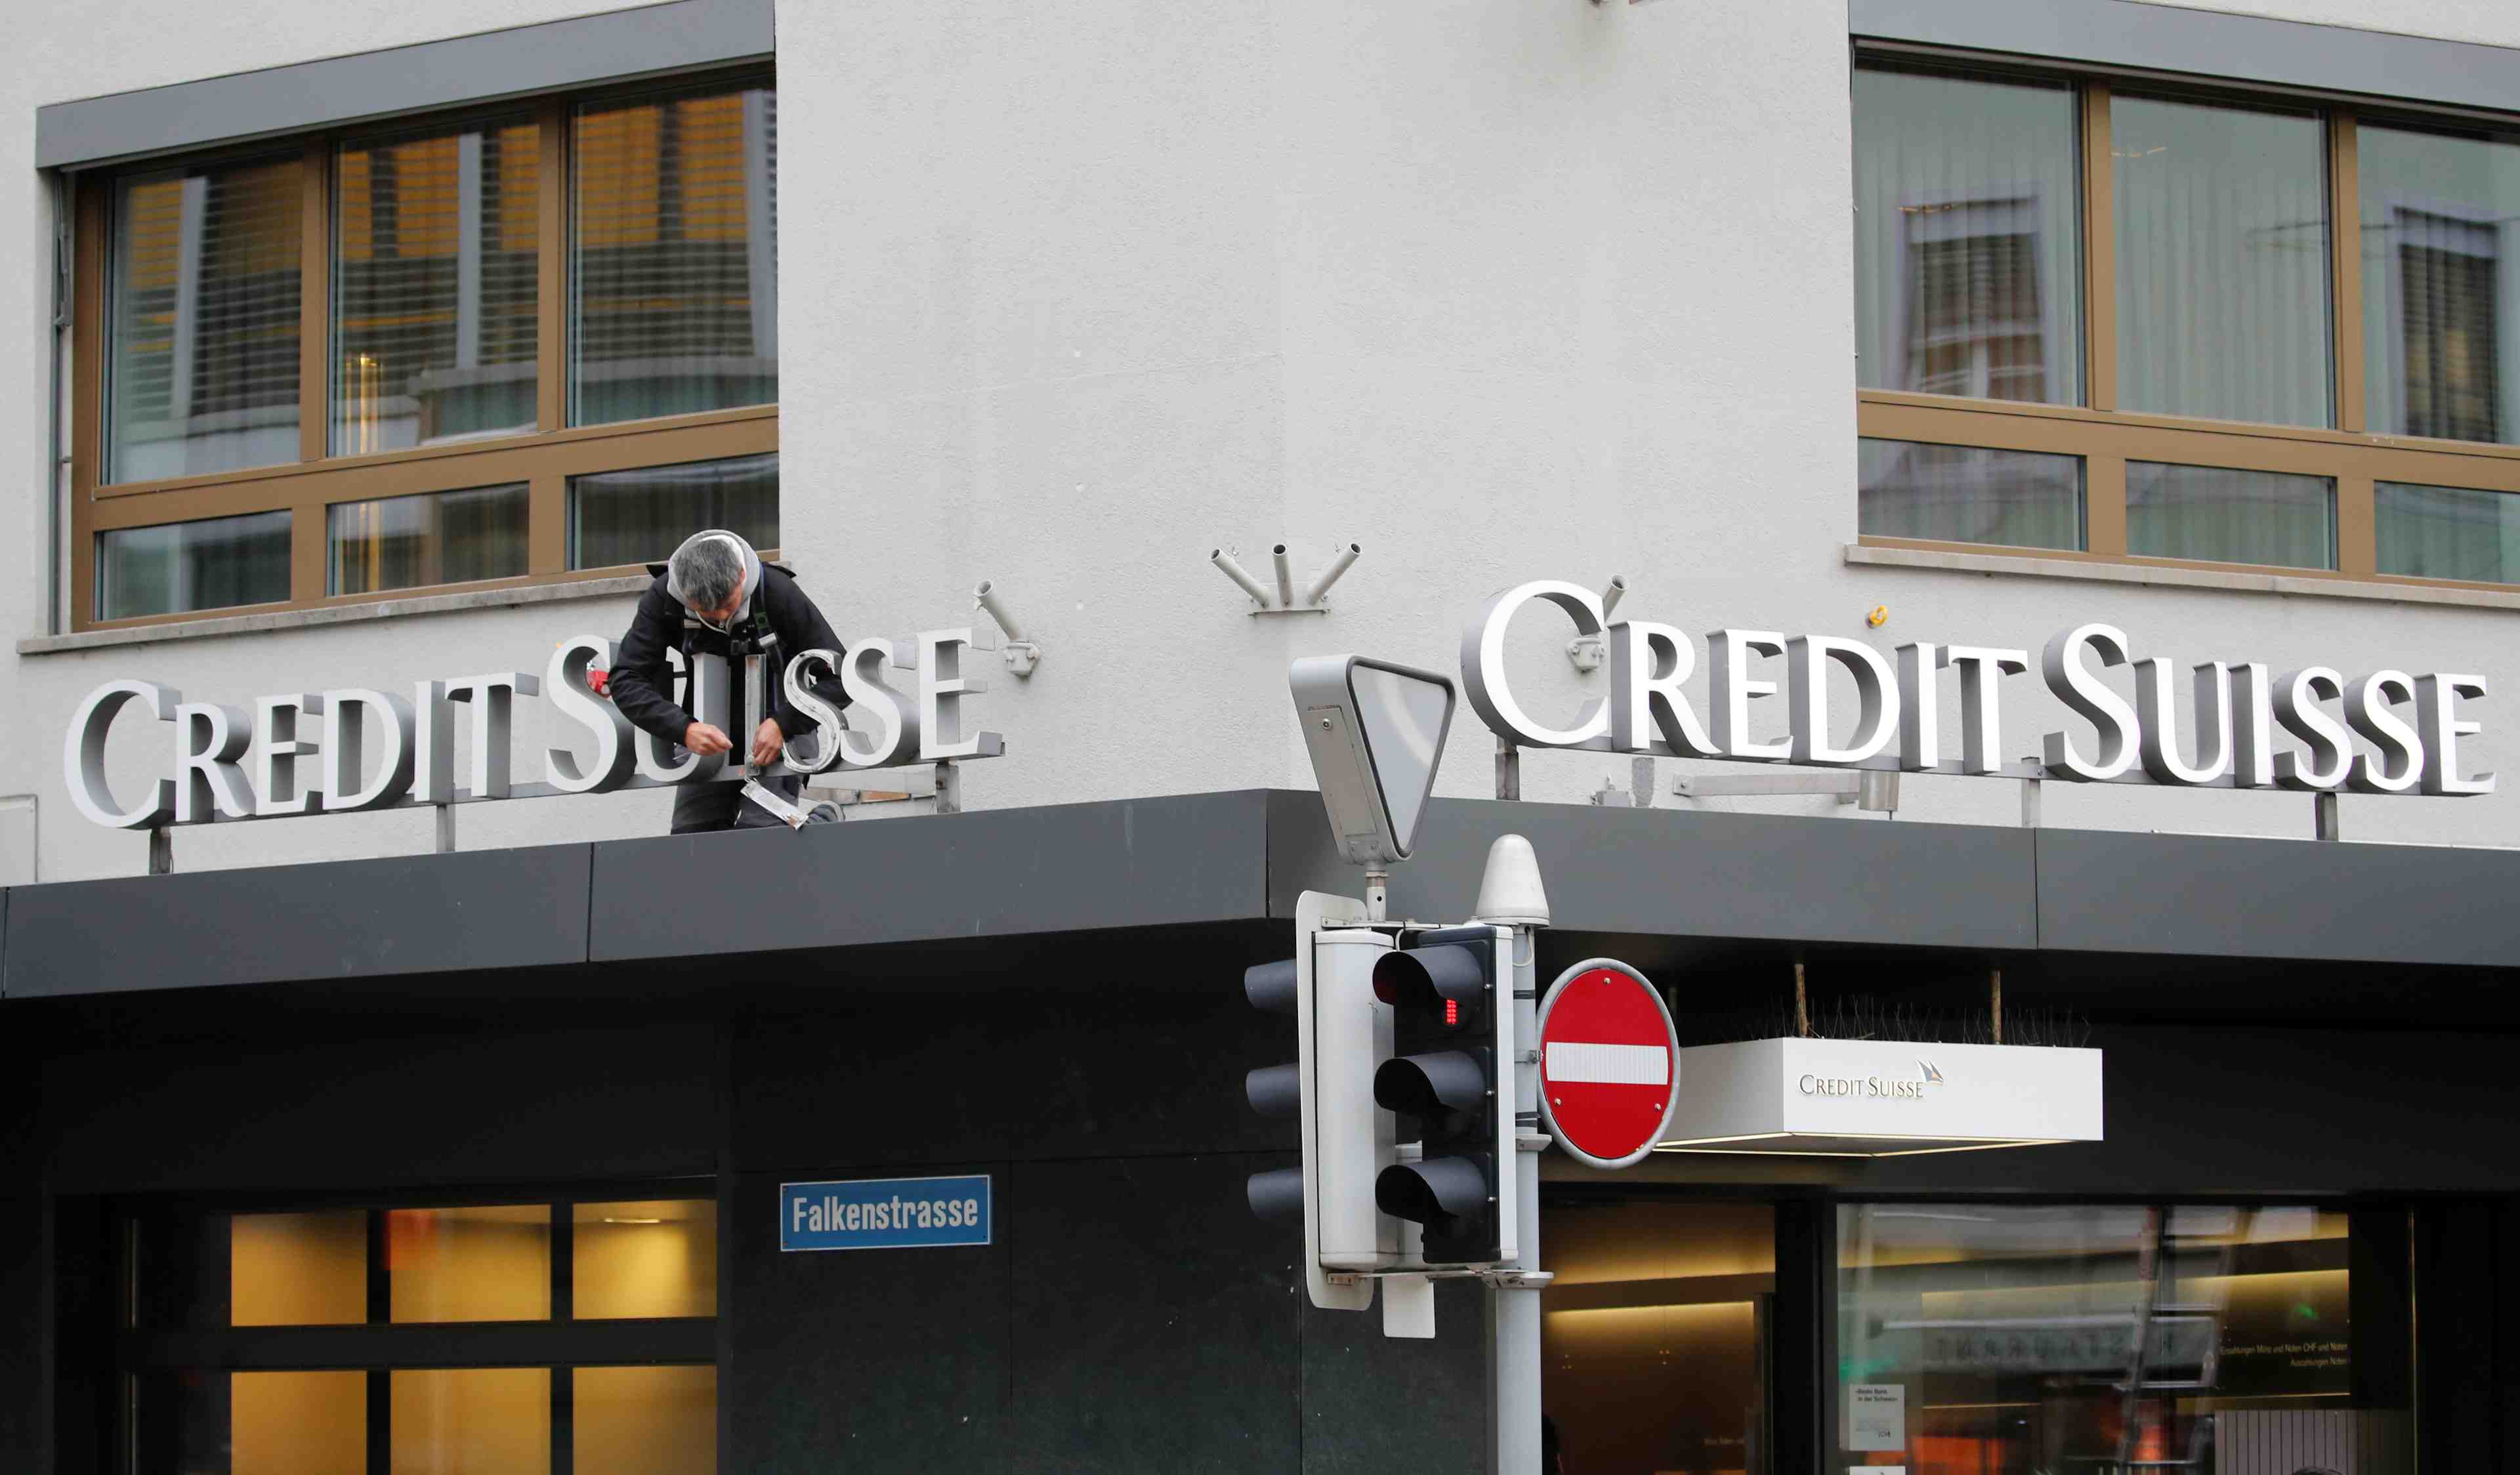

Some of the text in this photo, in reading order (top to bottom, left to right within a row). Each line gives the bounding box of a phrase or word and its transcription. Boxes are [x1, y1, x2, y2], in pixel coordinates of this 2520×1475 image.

[1461, 580, 2495, 797] CREDIT SUISSE
[64, 672, 538, 829] CREDIT
[1799, 1074, 1923, 1098] CREDIT SUISSE
[793, 1195, 978, 1232] Falkenstrasse
